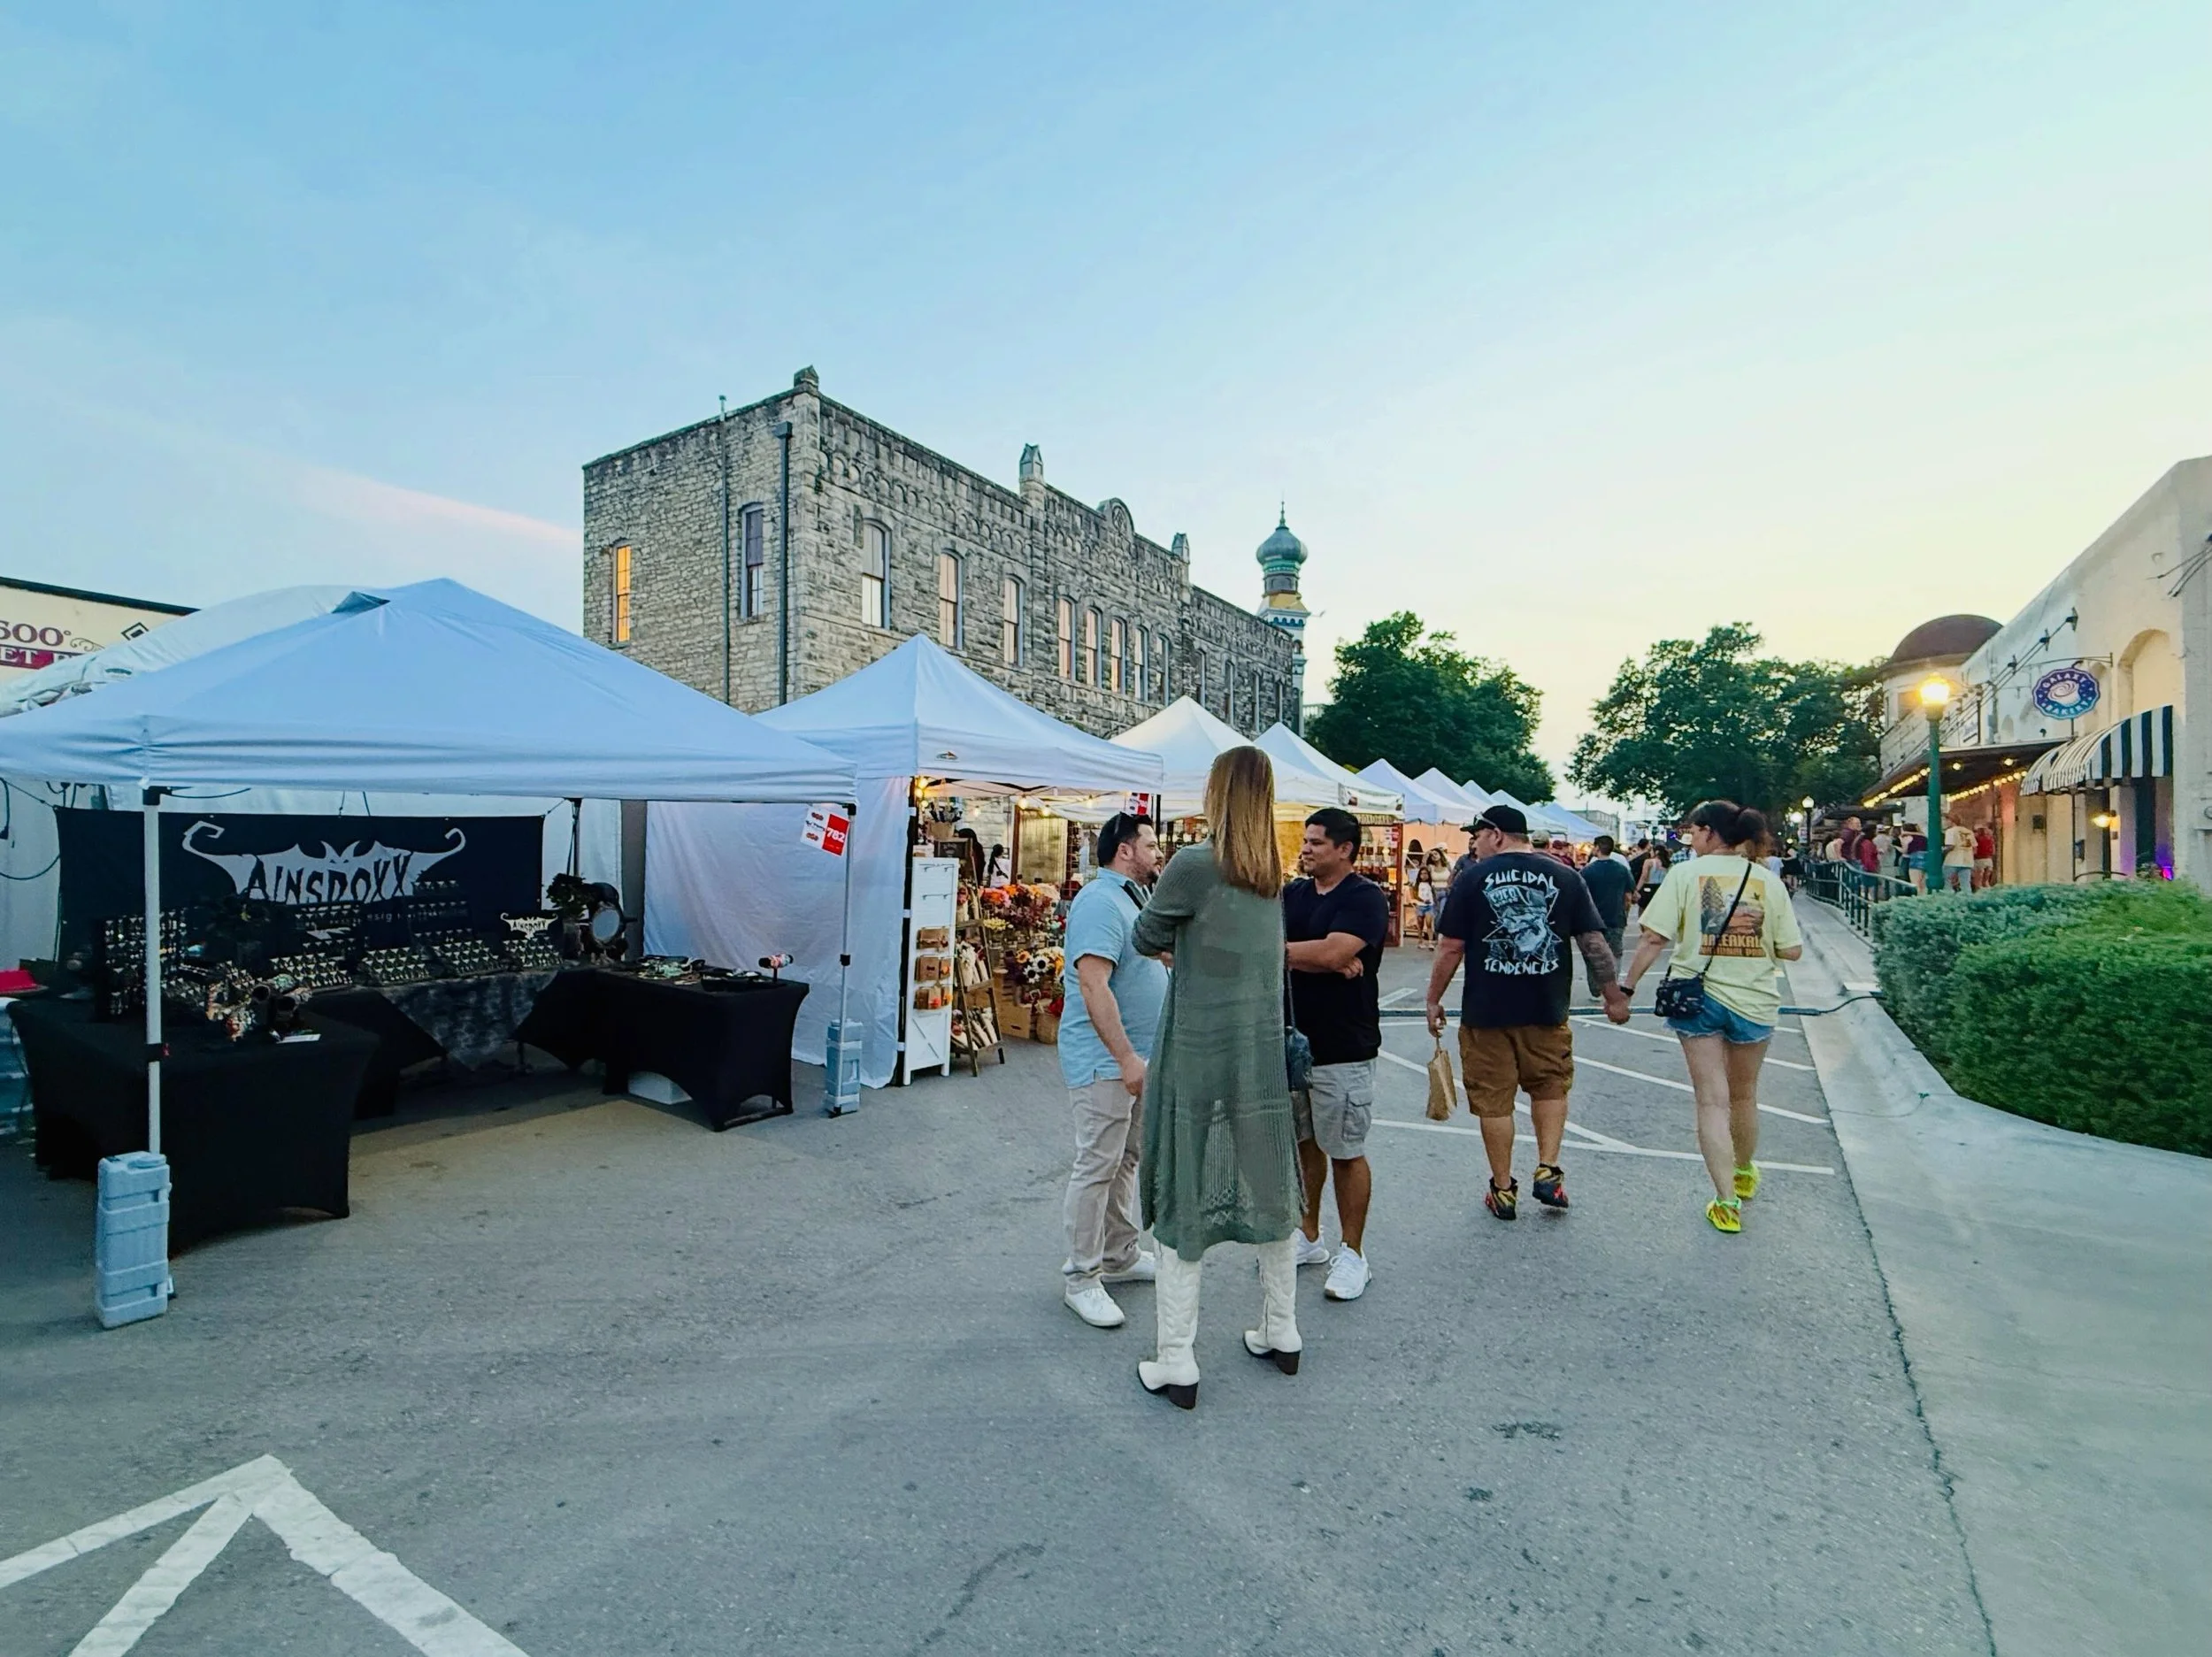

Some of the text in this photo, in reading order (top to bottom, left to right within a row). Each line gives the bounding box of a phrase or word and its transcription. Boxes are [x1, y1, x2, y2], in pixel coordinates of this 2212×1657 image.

[2042, 672, 2087, 688] GALAXY
[2045, 700, 2089, 716] BAKERY
[826, 826, 846, 843] 782
[1485, 869, 1560, 898] SUICIDAL
[1700, 933, 1761, 947] HAEAKAL
[1484, 957, 1559, 975] TENDENCIES
